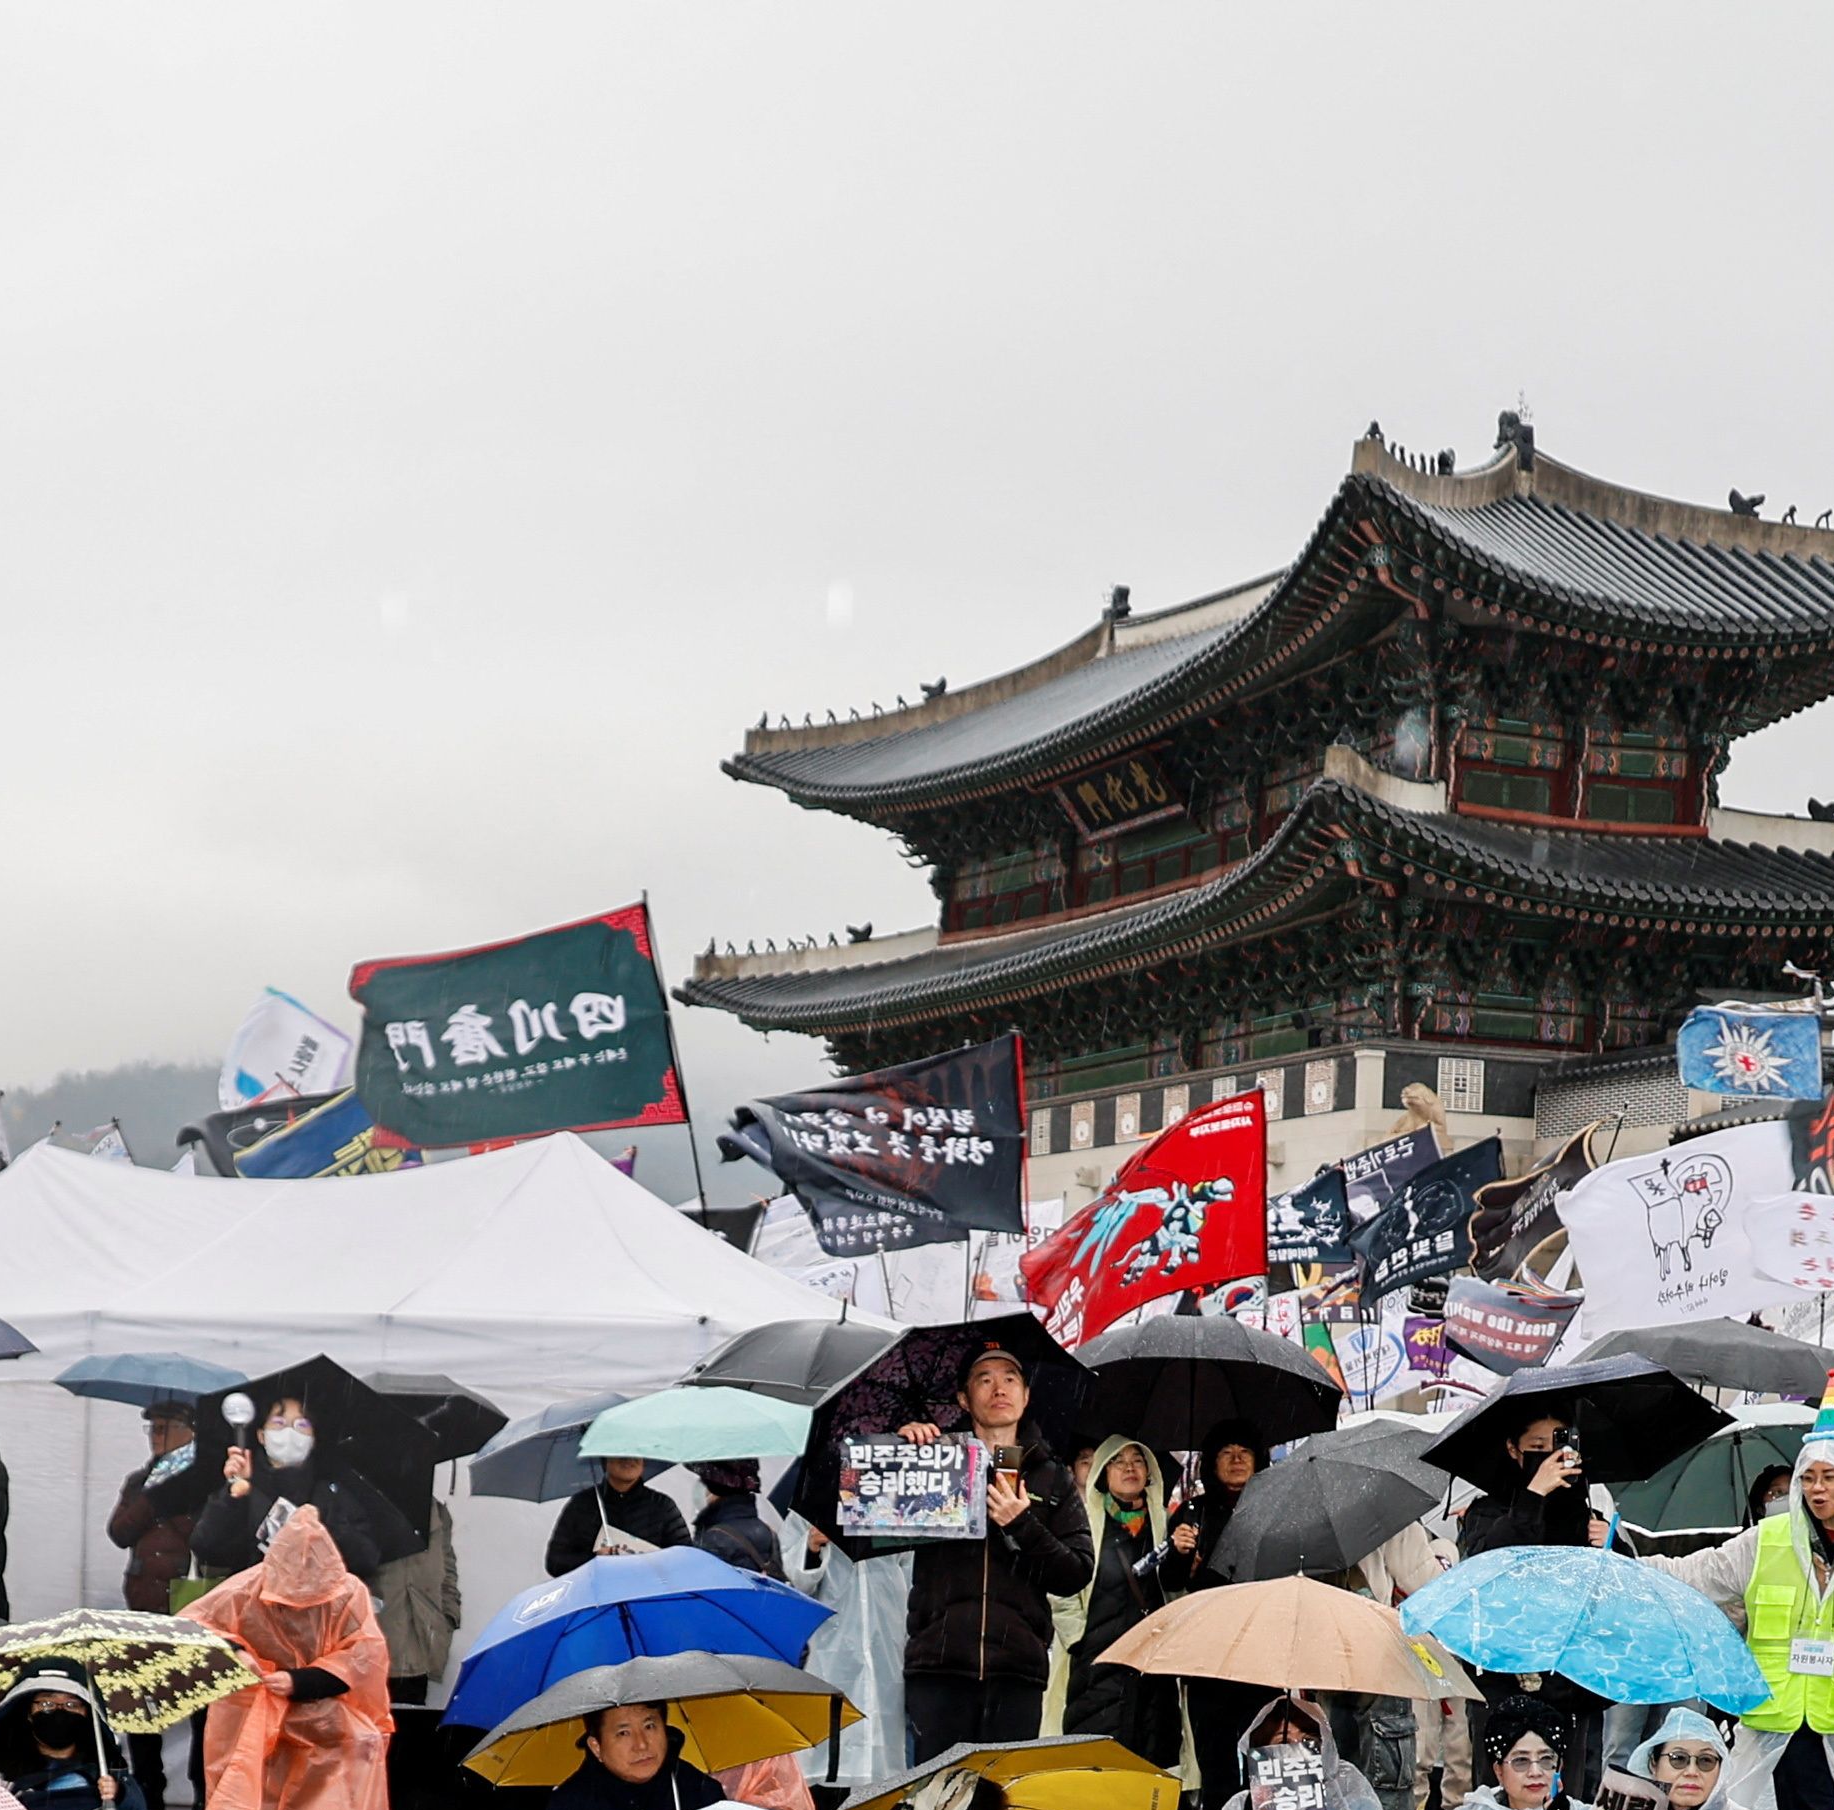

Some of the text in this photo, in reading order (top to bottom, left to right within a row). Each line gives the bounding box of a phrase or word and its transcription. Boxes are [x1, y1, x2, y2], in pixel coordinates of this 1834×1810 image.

[850, 1443, 964, 1471] 민주주의가
[859, 1470, 952, 1496] 승리했다
[1791, 1653, 1834, 1667] 자원봉사자
